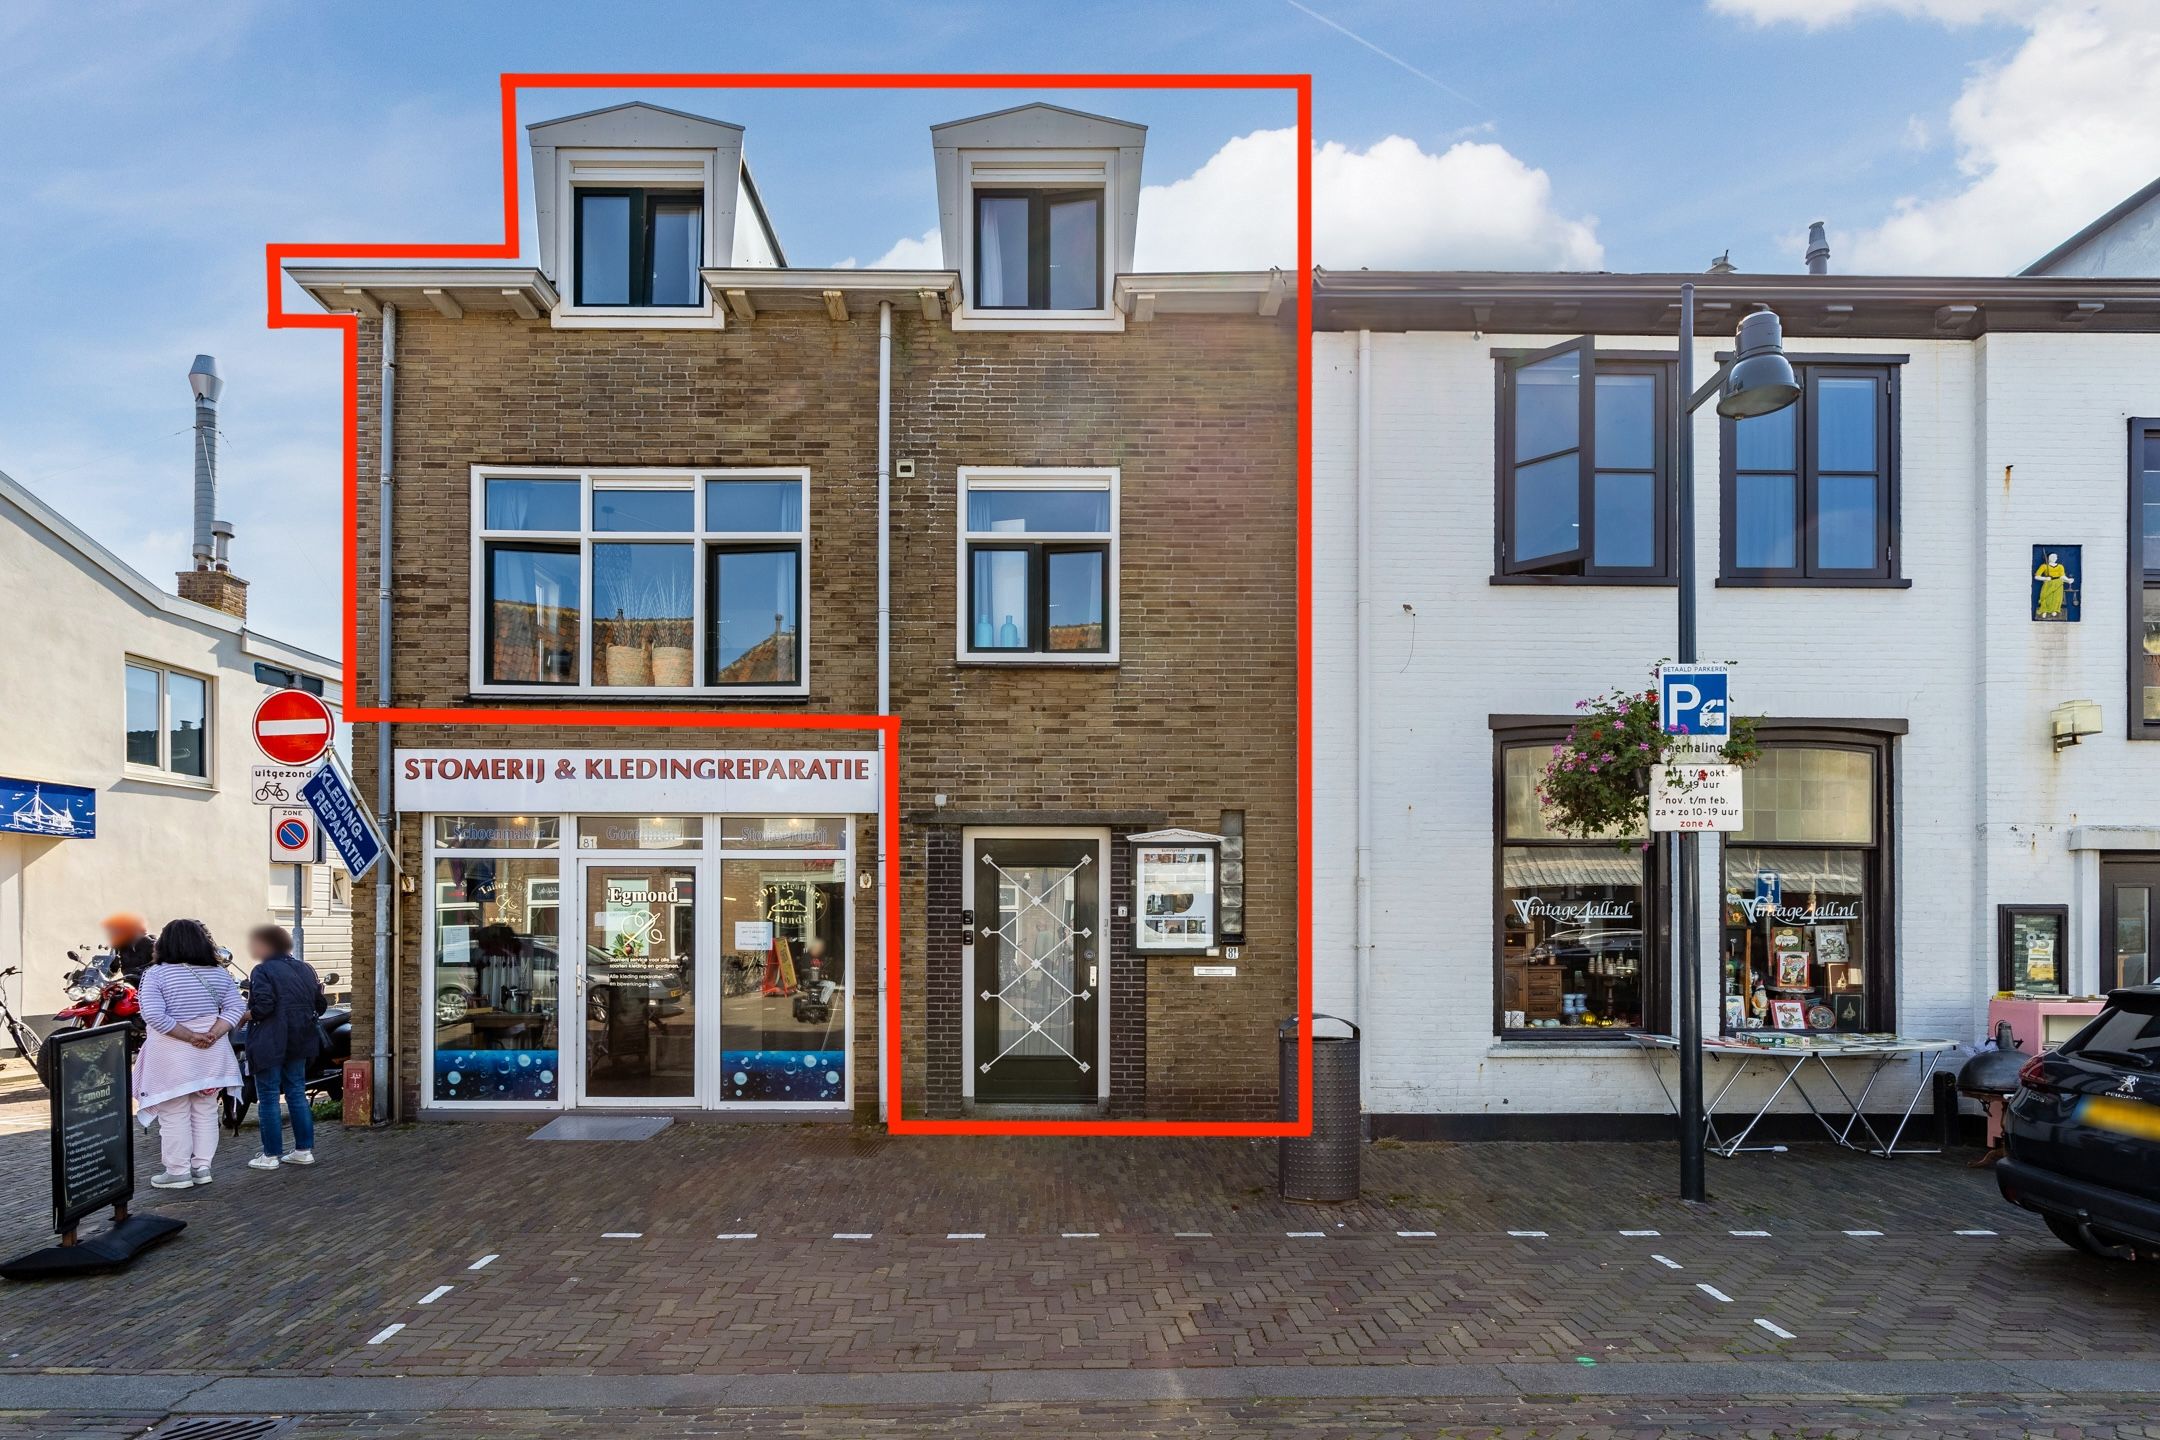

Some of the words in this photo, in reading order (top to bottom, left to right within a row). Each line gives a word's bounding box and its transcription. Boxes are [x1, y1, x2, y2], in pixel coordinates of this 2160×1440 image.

[1669, 684, 1701, 727] P
[255, 769, 317, 780] uitgezond
[404, 758, 545, 783] STOMERIJ
[554, 758, 576, 780] &
[585, 758, 869, 780] KLEDINGREPARATIE
[1710, 769, 1728, 777] okt.
[318, 767, 364, 842] KLEDING-
[1690, 796, 1706, 805] t/m
[1710, 796, 1728, 804] feb.
[313, 788, 366, 872] REPARATIE
[454, 825, 545, 841] Schoenmaker
[583, 838, 595, 848] 81
[478, 882, 508, 895] Tailor
[608, 886, 679, 906] Egmond
[761, 885, 779, 897] Dry
[1512, 896, 1633, 925] Vintage4all.nl
[1739, 896, 1858, 925] Vintage4all.nl
